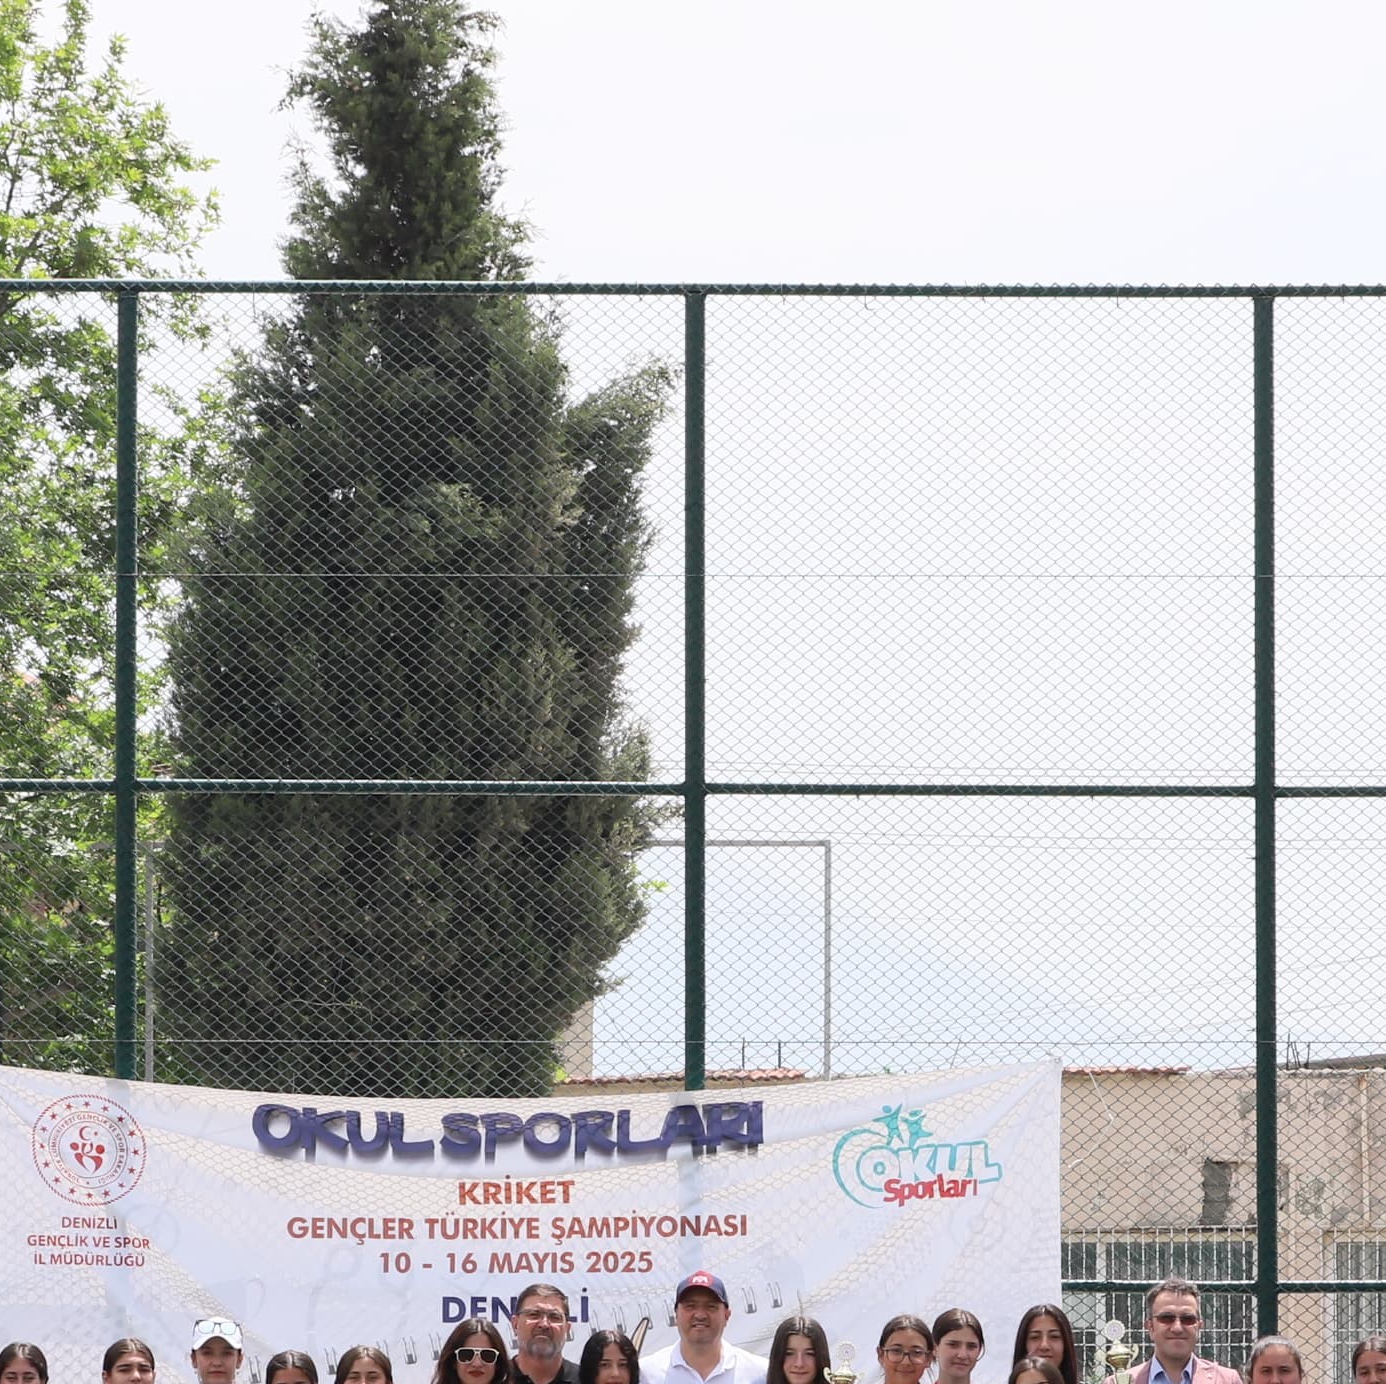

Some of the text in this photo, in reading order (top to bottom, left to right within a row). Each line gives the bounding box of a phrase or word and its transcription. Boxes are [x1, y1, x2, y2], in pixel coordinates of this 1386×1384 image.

[252, 1100, 764, 1162] OKUL SPORLARI
[457, 1174, 575, 1206] KRİKET
[62, 1215, 118, 1229] DENİZLİ
[286, 1209, 747, 1246] GENÇLER TÜRKİYE ŞAMPİYONASI
[27, 1232, 150, 1250] GENÇLİK VE SPOR
[33, 1250, 145, 1267] İL MÜDÜRLÜĞÜ
[379, 1251, 412, 1274] 10
[450, 1251, 479, 1274] 16
[488, 1251, 575, 1274] MAYIS
[585, 1250, 654, 1274] 2025
